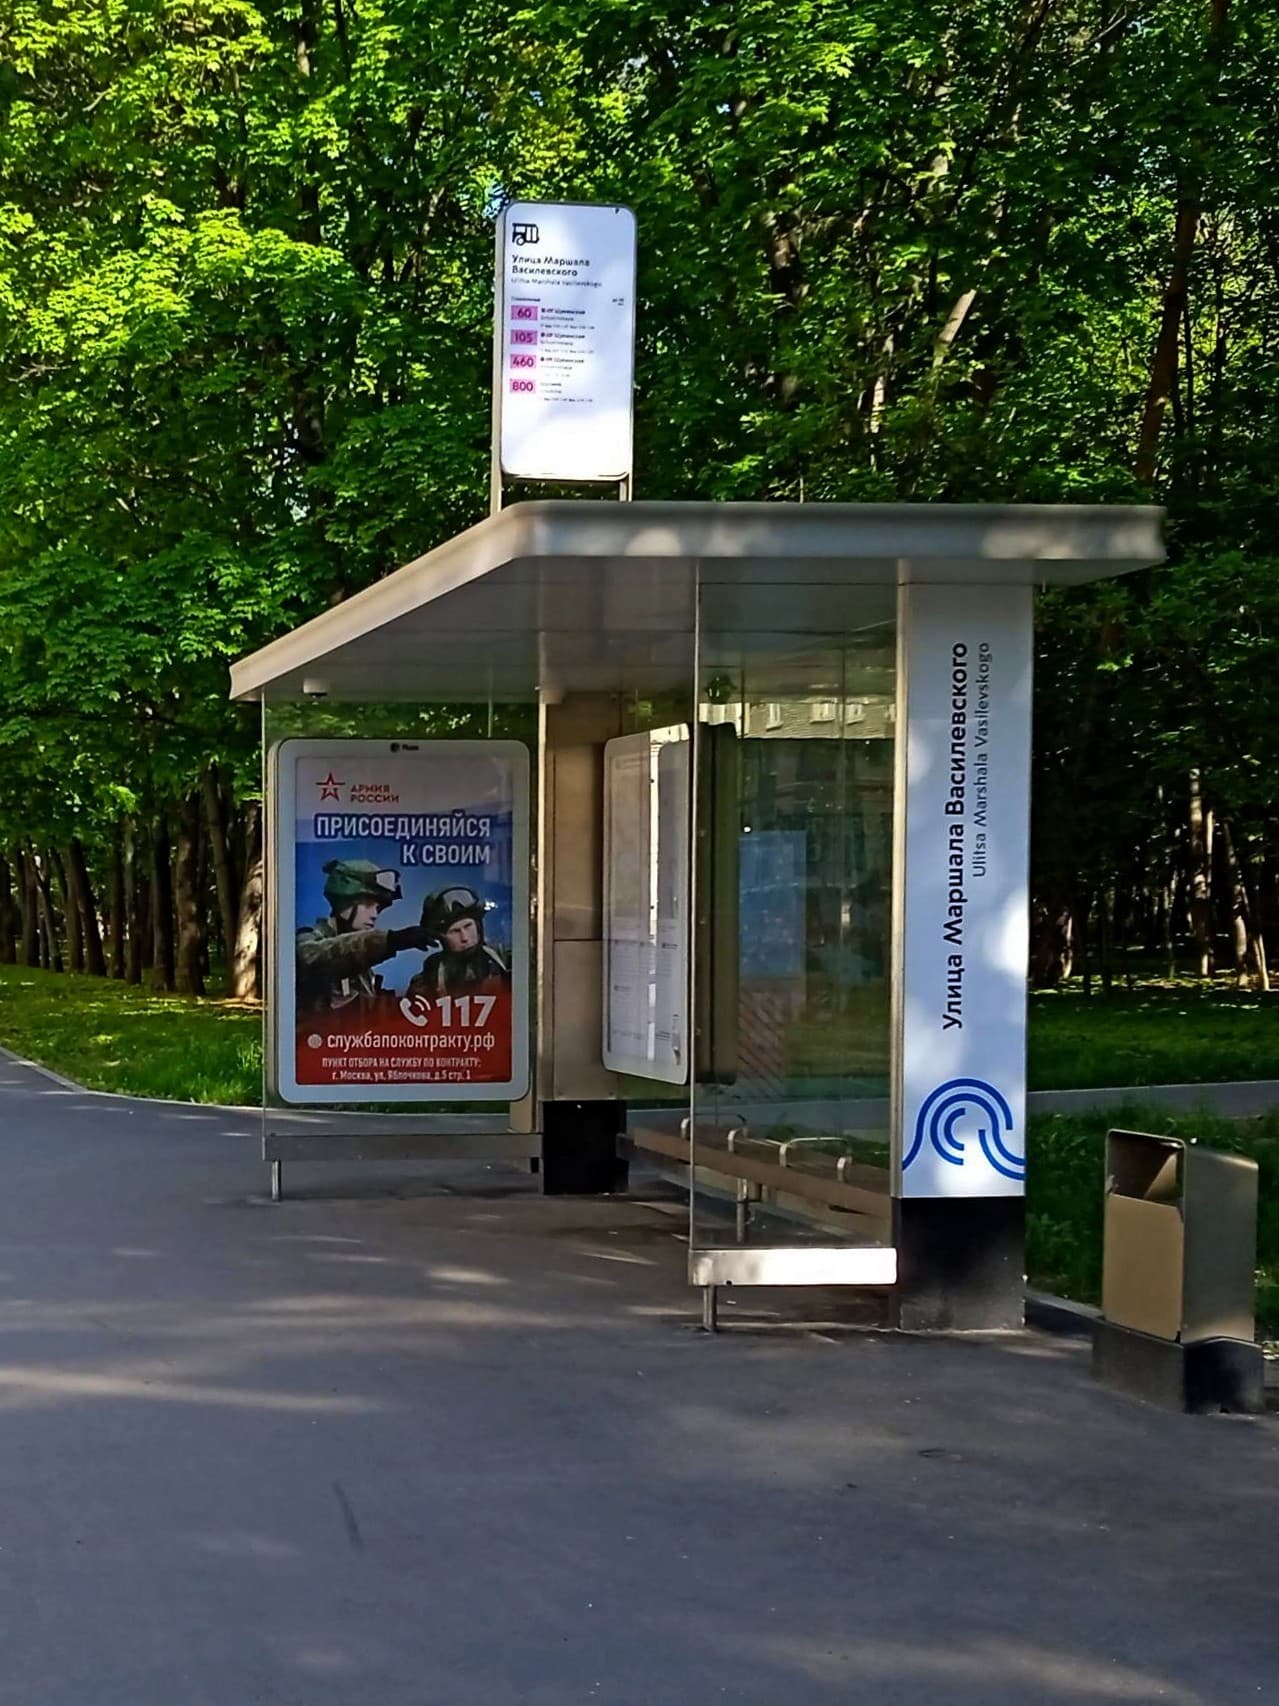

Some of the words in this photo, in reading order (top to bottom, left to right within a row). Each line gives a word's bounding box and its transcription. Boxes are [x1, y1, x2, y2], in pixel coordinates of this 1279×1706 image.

[512, 254, 541, 264] Улица
[544, 256, 590, 267] Маршала
[512, 265, 578, 277] Василевского
[517, 308, 532, 318] 60
[515, 332, 533, 343] 105
[512, 357, 534, 367] 460
[512, 381, 534, 392] 800
[974, 642, 993, 748] Vasilevskogo
[945, 642, 968, 816] Василевского
[351, 784, 390, 793] АРМИЯ
[351, 793, 399, 803] РОССИИ
[973, 753, 988, 827] Marshala
[317, 813, 491, 840] ПРИСОЕДИНЯЙСЯ
[403, 844, 415, 864] К
[422, 844, 491, 864] СВОИМ
[973, 833, 986, 877] Ulitsa
[943, 824, 968, 945] Маршала
[942, 954, 965, 1030] Улица
[435, 995, 497, 1027] 117
[327, 1030, 496, 1052] службапоконтракту.рф
[322, 1057, 347, 1067] ПУНКТ
[349, 1057, 377, 1067] ОТБОРА
[379, 1057, 390, 1067] НА
[391, 1057, 421, 1067] СЛУЖБУ
[423, 1057, 434, 1067] ПО
